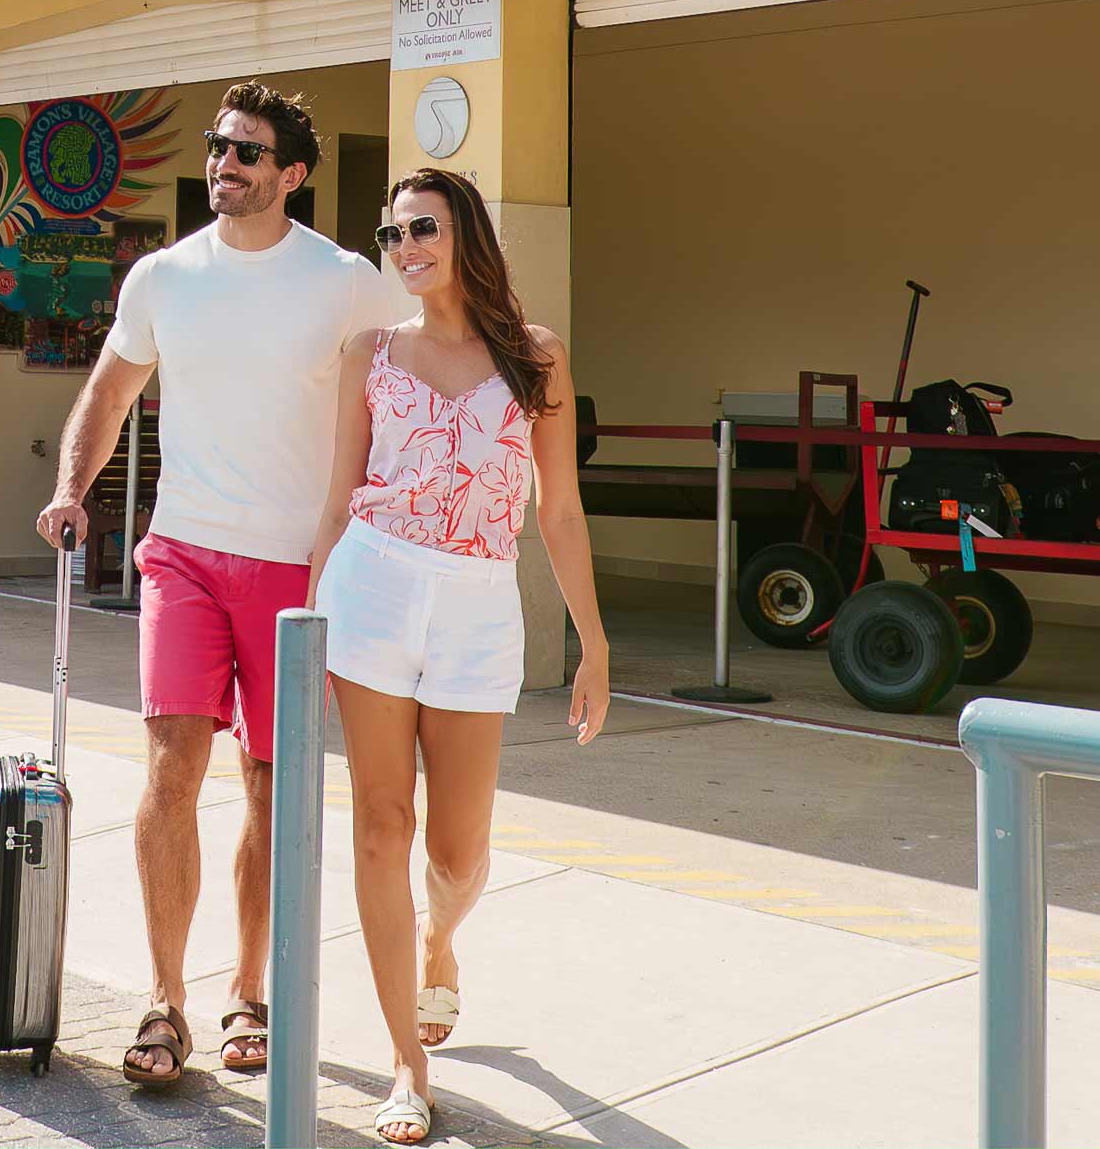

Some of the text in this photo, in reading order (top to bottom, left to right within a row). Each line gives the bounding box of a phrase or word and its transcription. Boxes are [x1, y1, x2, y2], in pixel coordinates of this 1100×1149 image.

[426, 8, 464, 28] ONLY
[398, 26, 492, 48] No Solicitation Allowed
[77, 105, 117, 182] VILLAGE
[41, 183, 103, 211] RESORT
